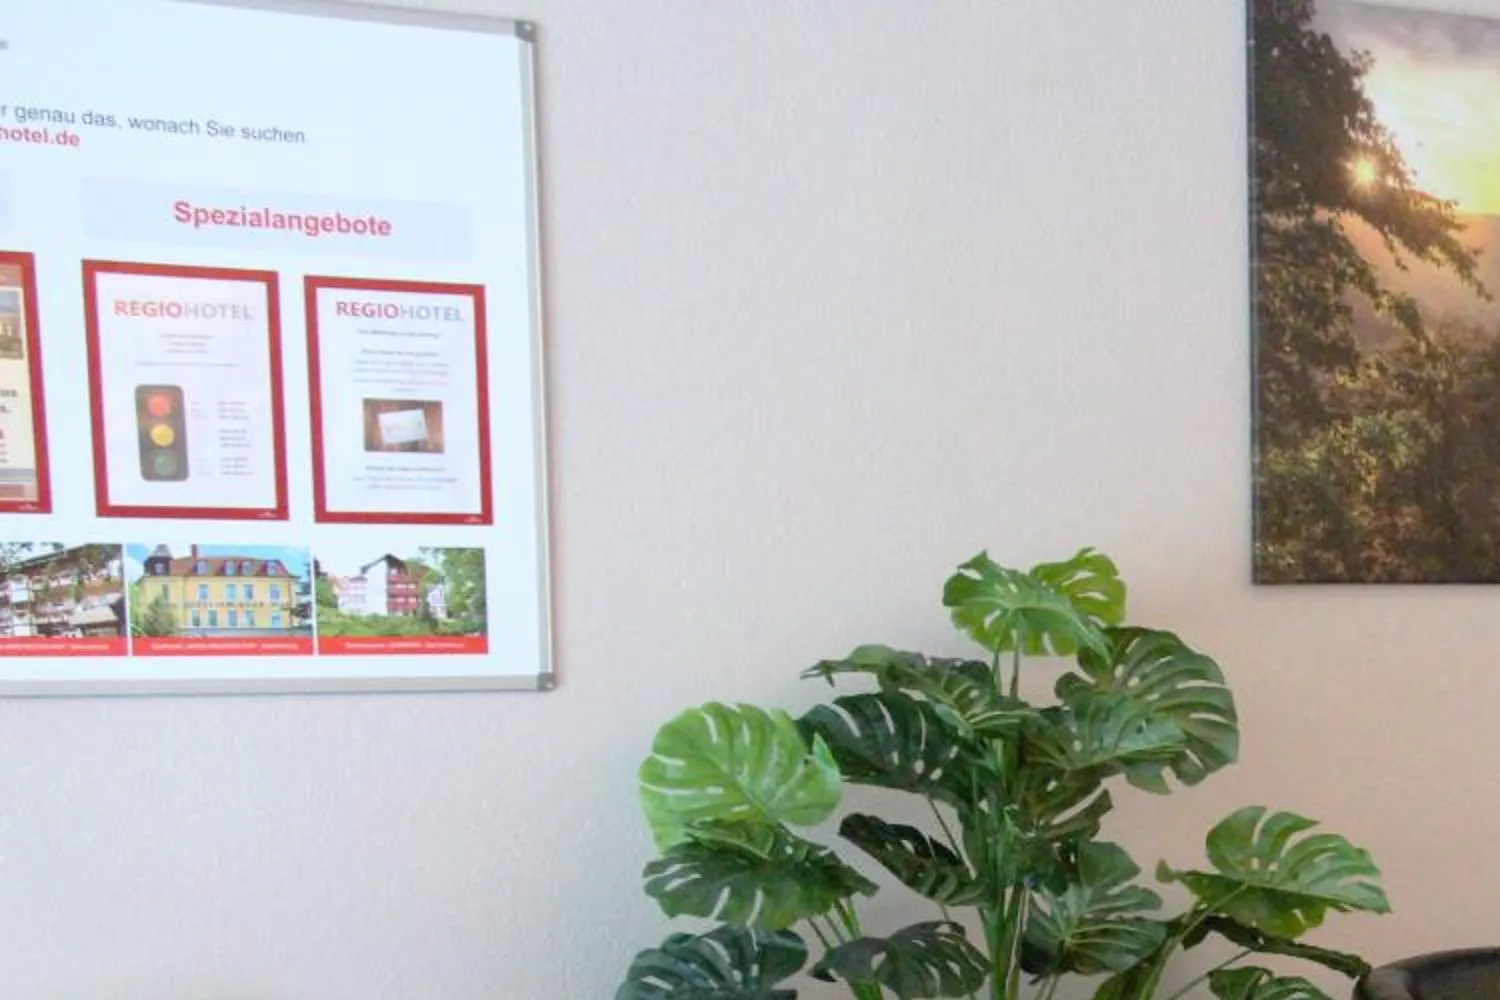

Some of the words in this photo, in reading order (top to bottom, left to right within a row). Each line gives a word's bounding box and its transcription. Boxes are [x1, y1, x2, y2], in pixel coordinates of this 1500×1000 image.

[14, 105, 76, 124] genau
[81, 110, 122, 130] das,
[127, 116, 200, 135] wonach
[206, 119, 235, 138] Sie
[174, 200, 393, 238] Spezialangebote
[114, 299, 253, 321] REGIOHOTEL
[335, 301, 465, 322] REGIOHOTEL
